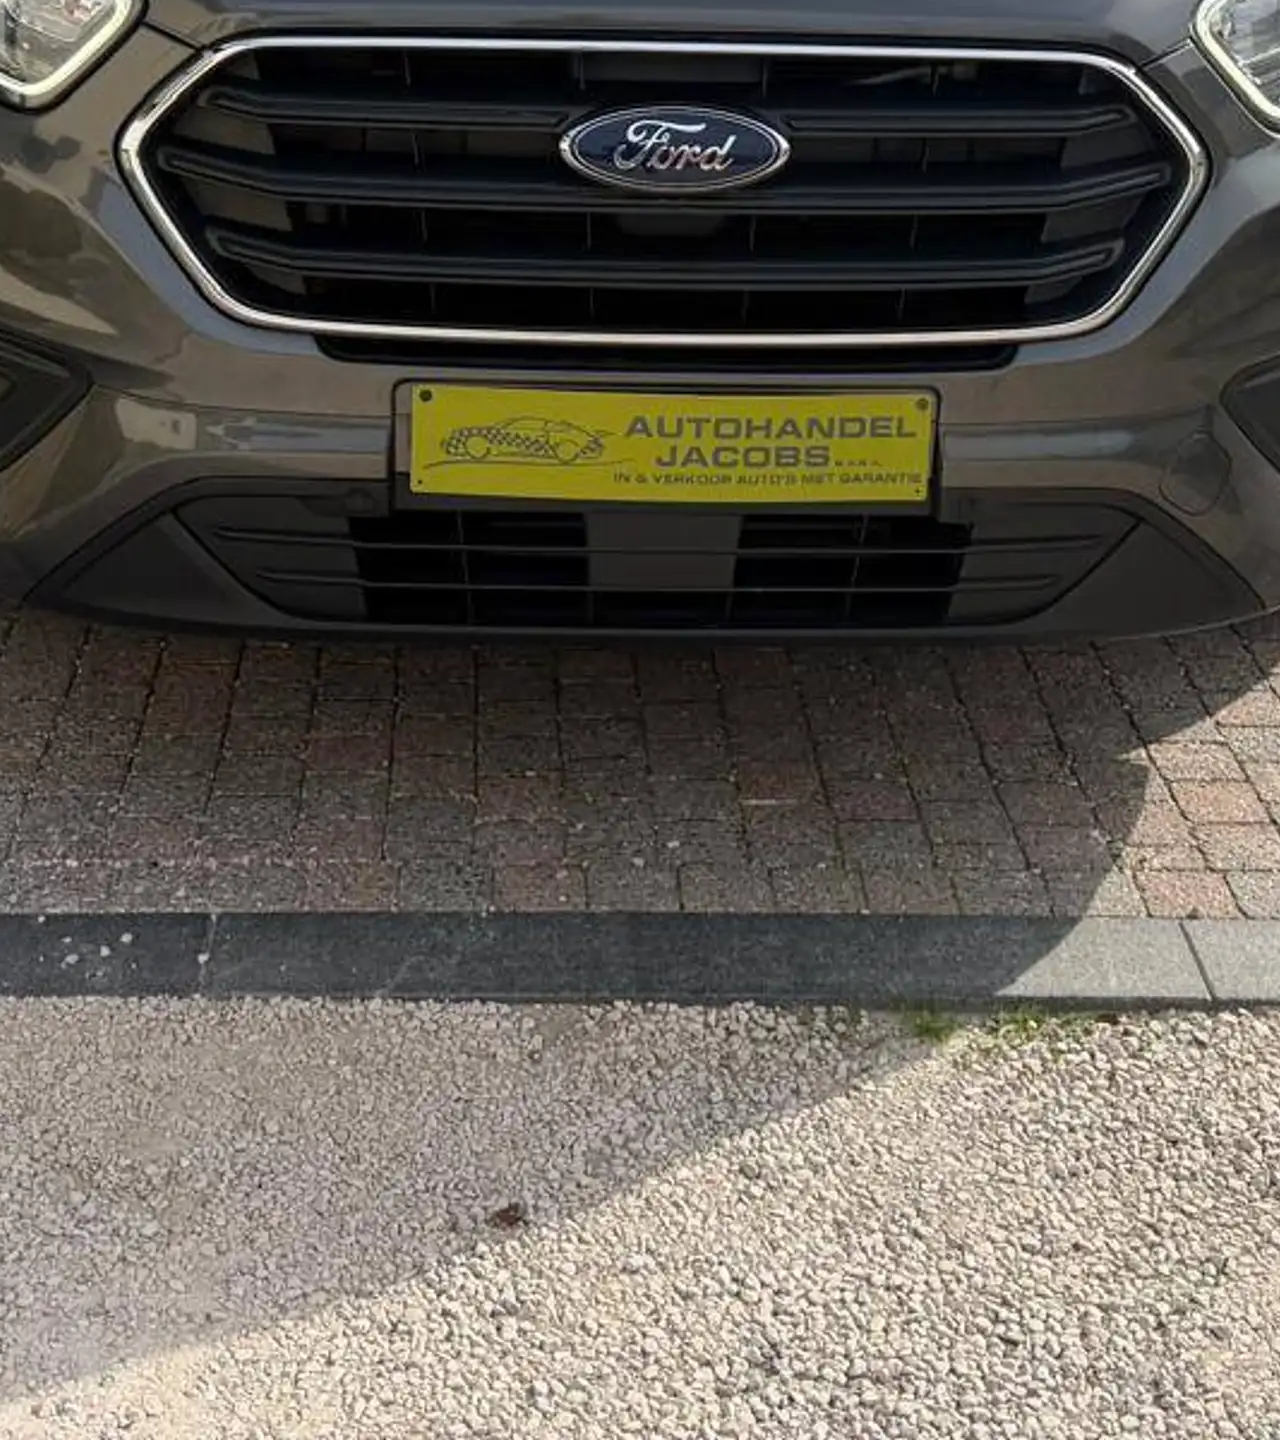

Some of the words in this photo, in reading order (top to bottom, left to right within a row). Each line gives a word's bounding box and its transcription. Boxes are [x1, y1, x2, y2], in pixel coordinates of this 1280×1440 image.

[613, 119, 737, 171] Ford
[624, 414, 917, 439] AUTOHANDEL
[655, 445, 831, 468] JACOBS
